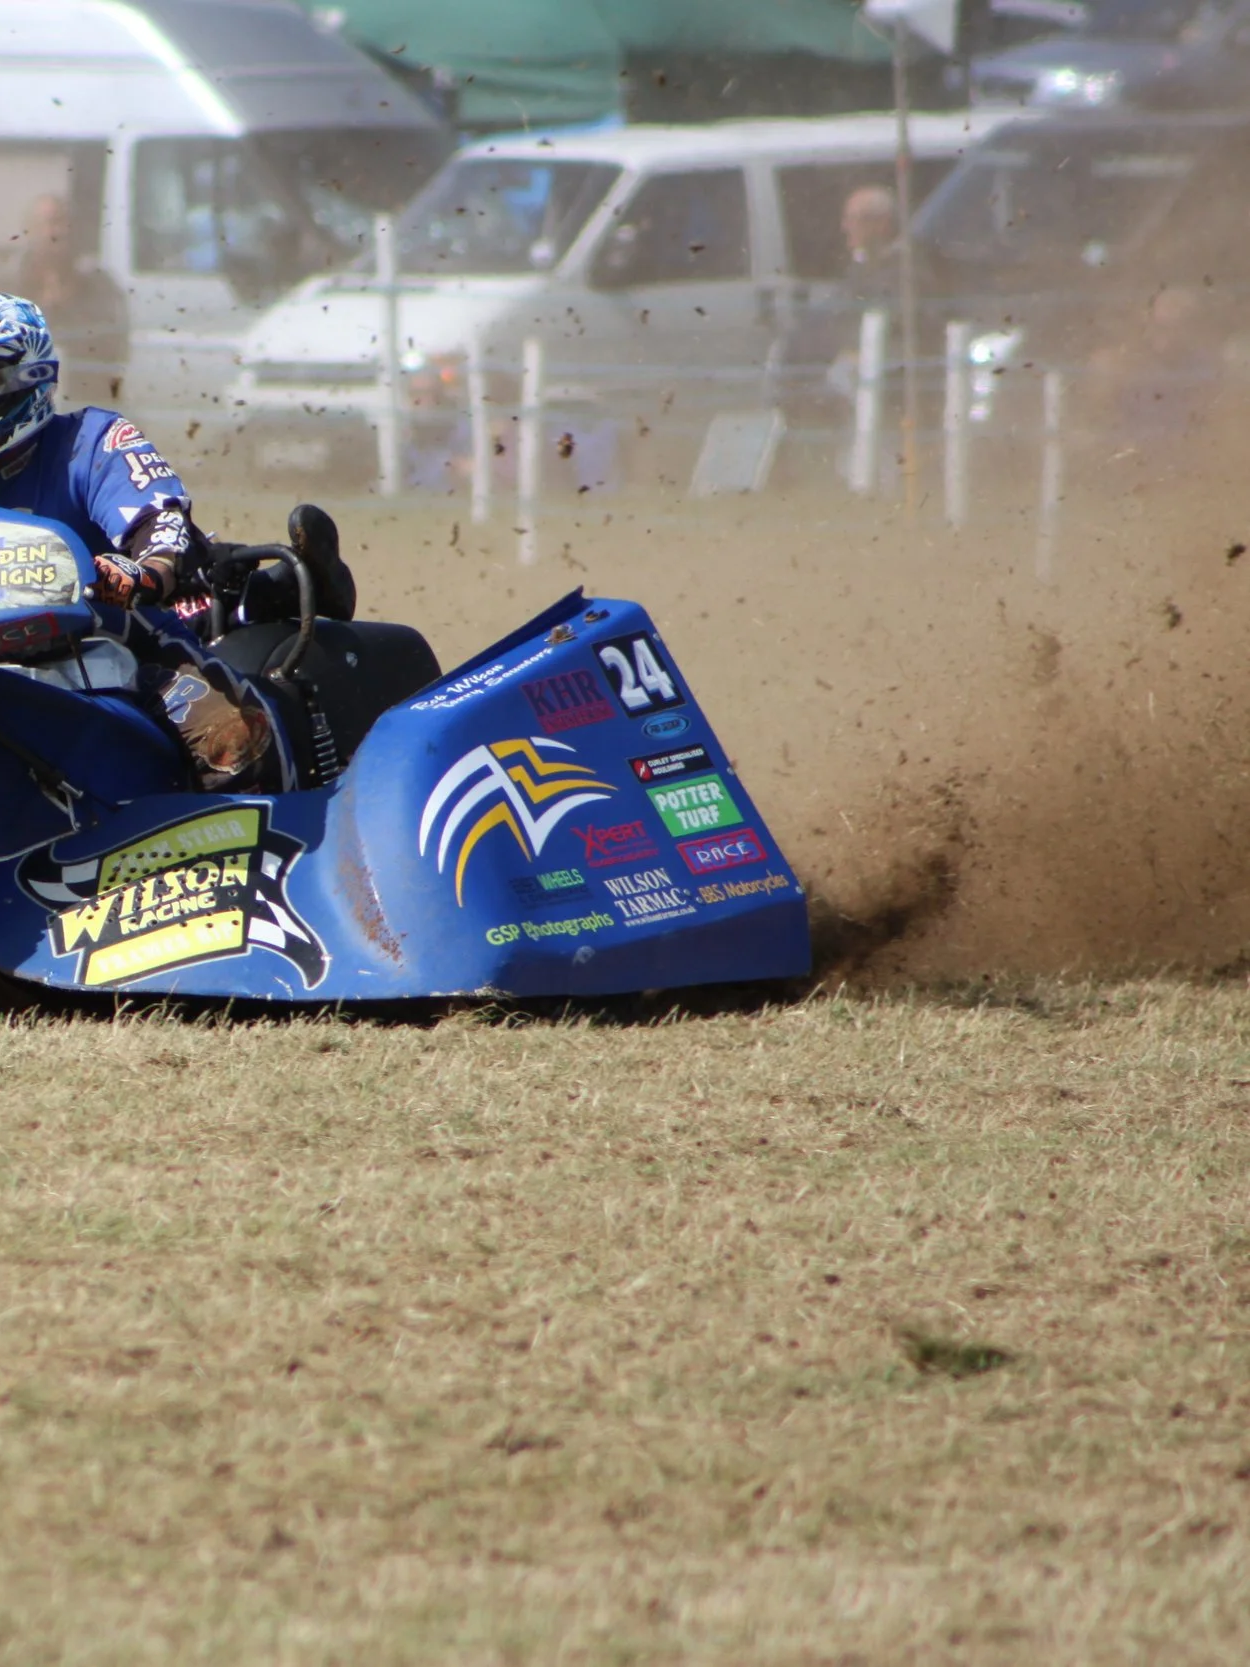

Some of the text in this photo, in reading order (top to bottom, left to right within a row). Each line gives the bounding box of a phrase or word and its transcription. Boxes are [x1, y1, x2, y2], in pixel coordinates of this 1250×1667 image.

[410, 663, 504, 711] Rob Wilson
[600, 637, 678, 710] 24
[521, 668, 606, 717] KHR
[654, 781, 725, 812] POTTER
[675, 803, 721, 830] TURF
[696, 840, 750, 864] RACE
[536, 868, 586, 891] WHEELS
[603, 867, 673, 897] WILSON
[723, 869, 789, 898] Motorcycles
[58, 852, 251, 953] WILSON
[118, 891, 217, 935] RACING
[614, 888, 687, 918] TARMAC
[485, 910, 615, 946] GSP Photographs
